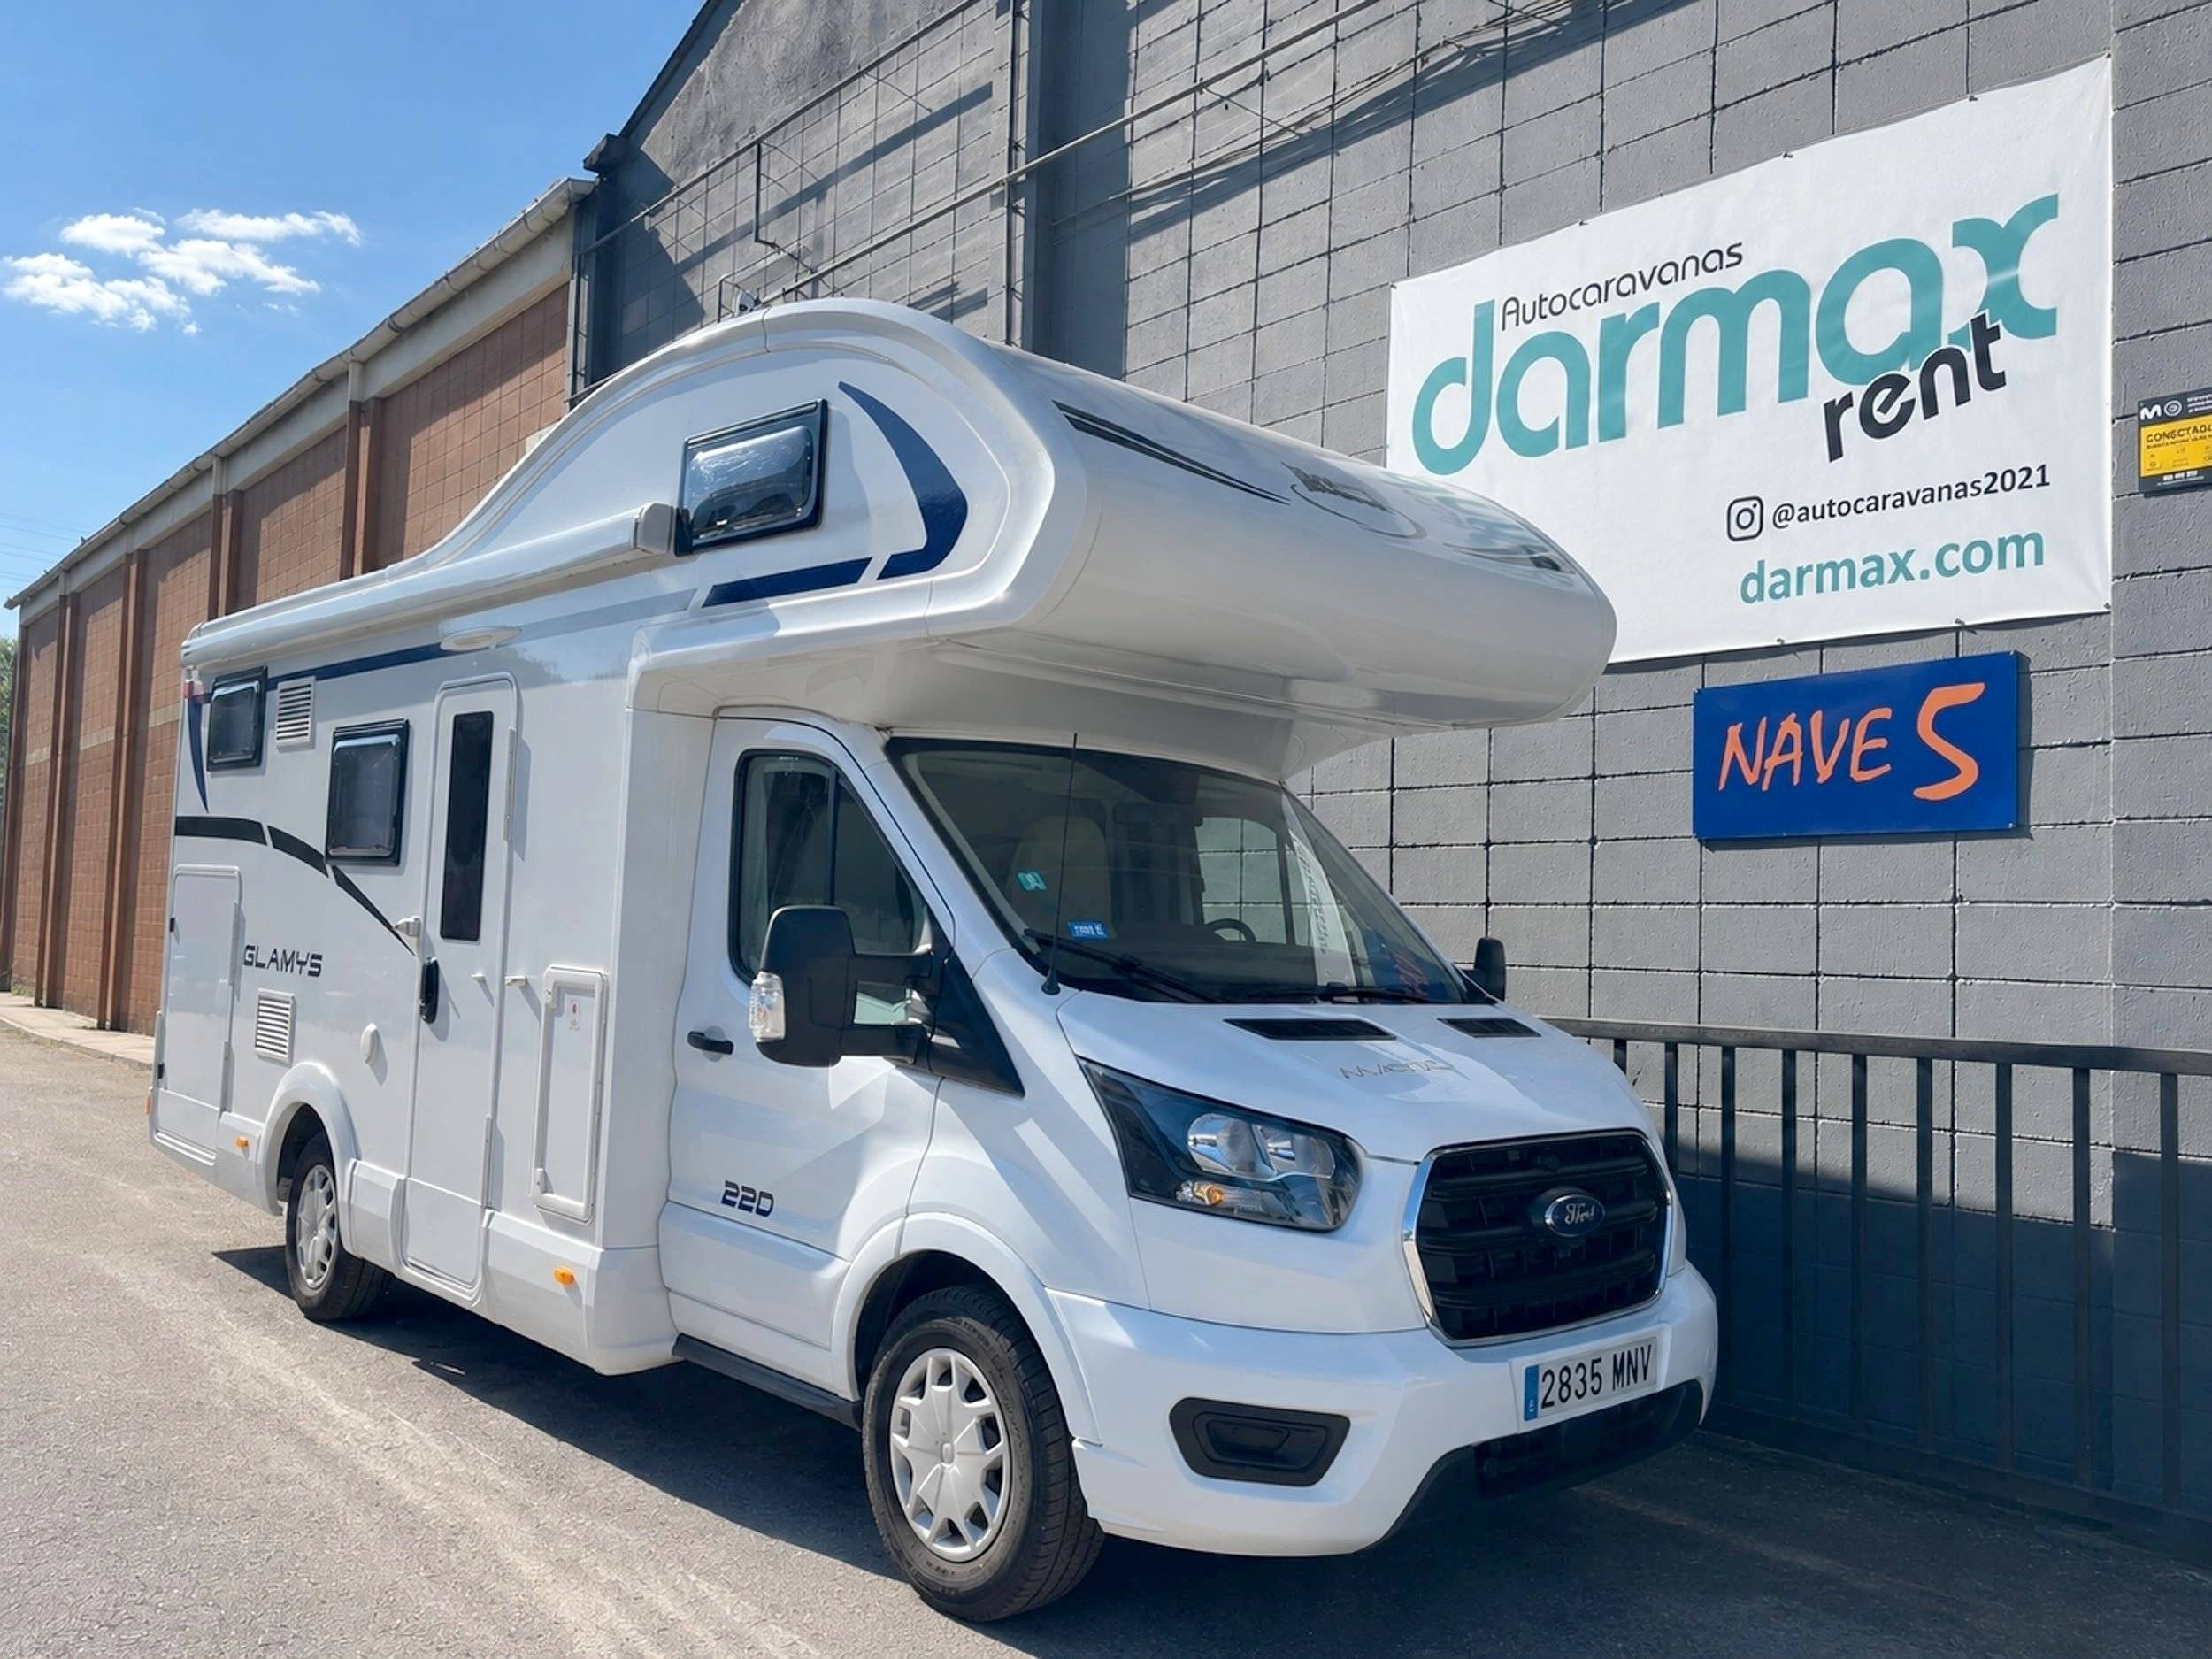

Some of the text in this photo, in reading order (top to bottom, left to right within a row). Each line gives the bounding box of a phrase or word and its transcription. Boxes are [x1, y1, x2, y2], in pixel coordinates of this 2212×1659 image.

[1501, 241, 1745, 333] Autocaravanas
[1412, 193, 2060, 477] darmax
[1823, 311, 2008, 464] rent
[1772, 463, 2051, 531] @autocaravanas2021
[1740, 530, 2045, 605] darmax.com
[1717, 707, 1893, 793] NAVE
[243, 943, 324, 978] GLAMYS
[720, 1179, 775, 1218] 220
[1564, 1202, 1595, 1225] Ford
[1540, 1343, 1652, 1409] 2835 MNV
